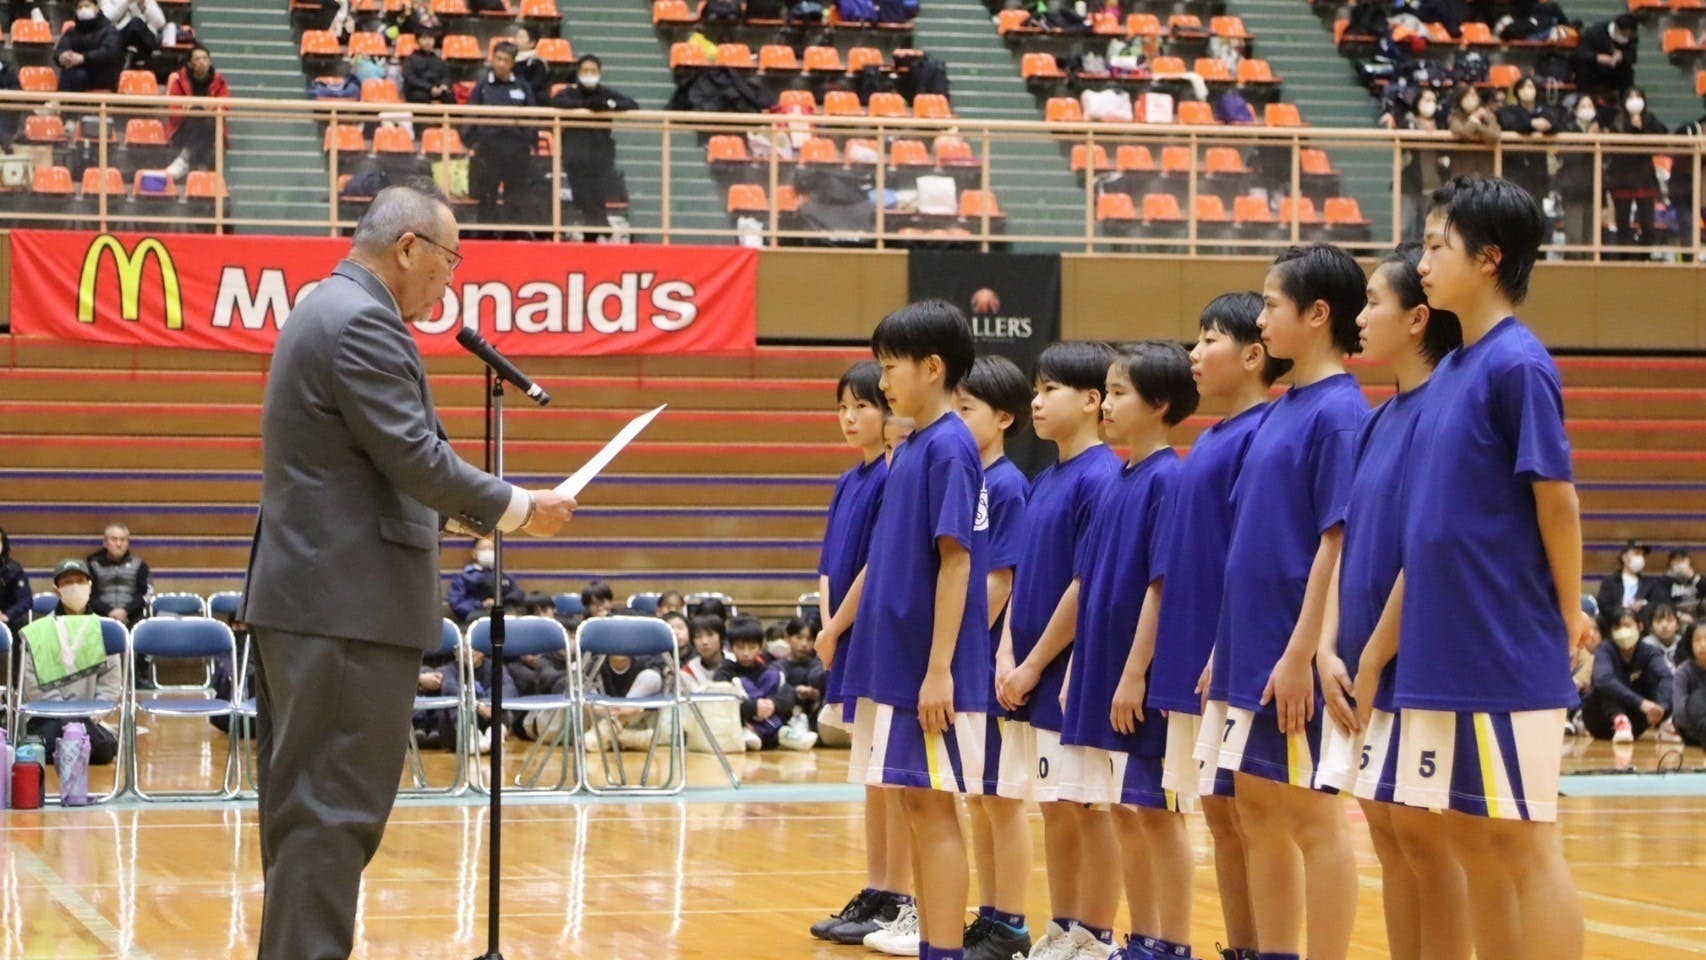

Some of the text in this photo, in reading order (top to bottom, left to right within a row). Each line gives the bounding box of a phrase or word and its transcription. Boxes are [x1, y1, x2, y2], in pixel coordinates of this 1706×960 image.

[210, 265, 697, 334] Monald's
[1223, 719, 1236, 742] 7
[1036, 757, 1049, 779] 0
[1419, 750, 1436, 778] 5
